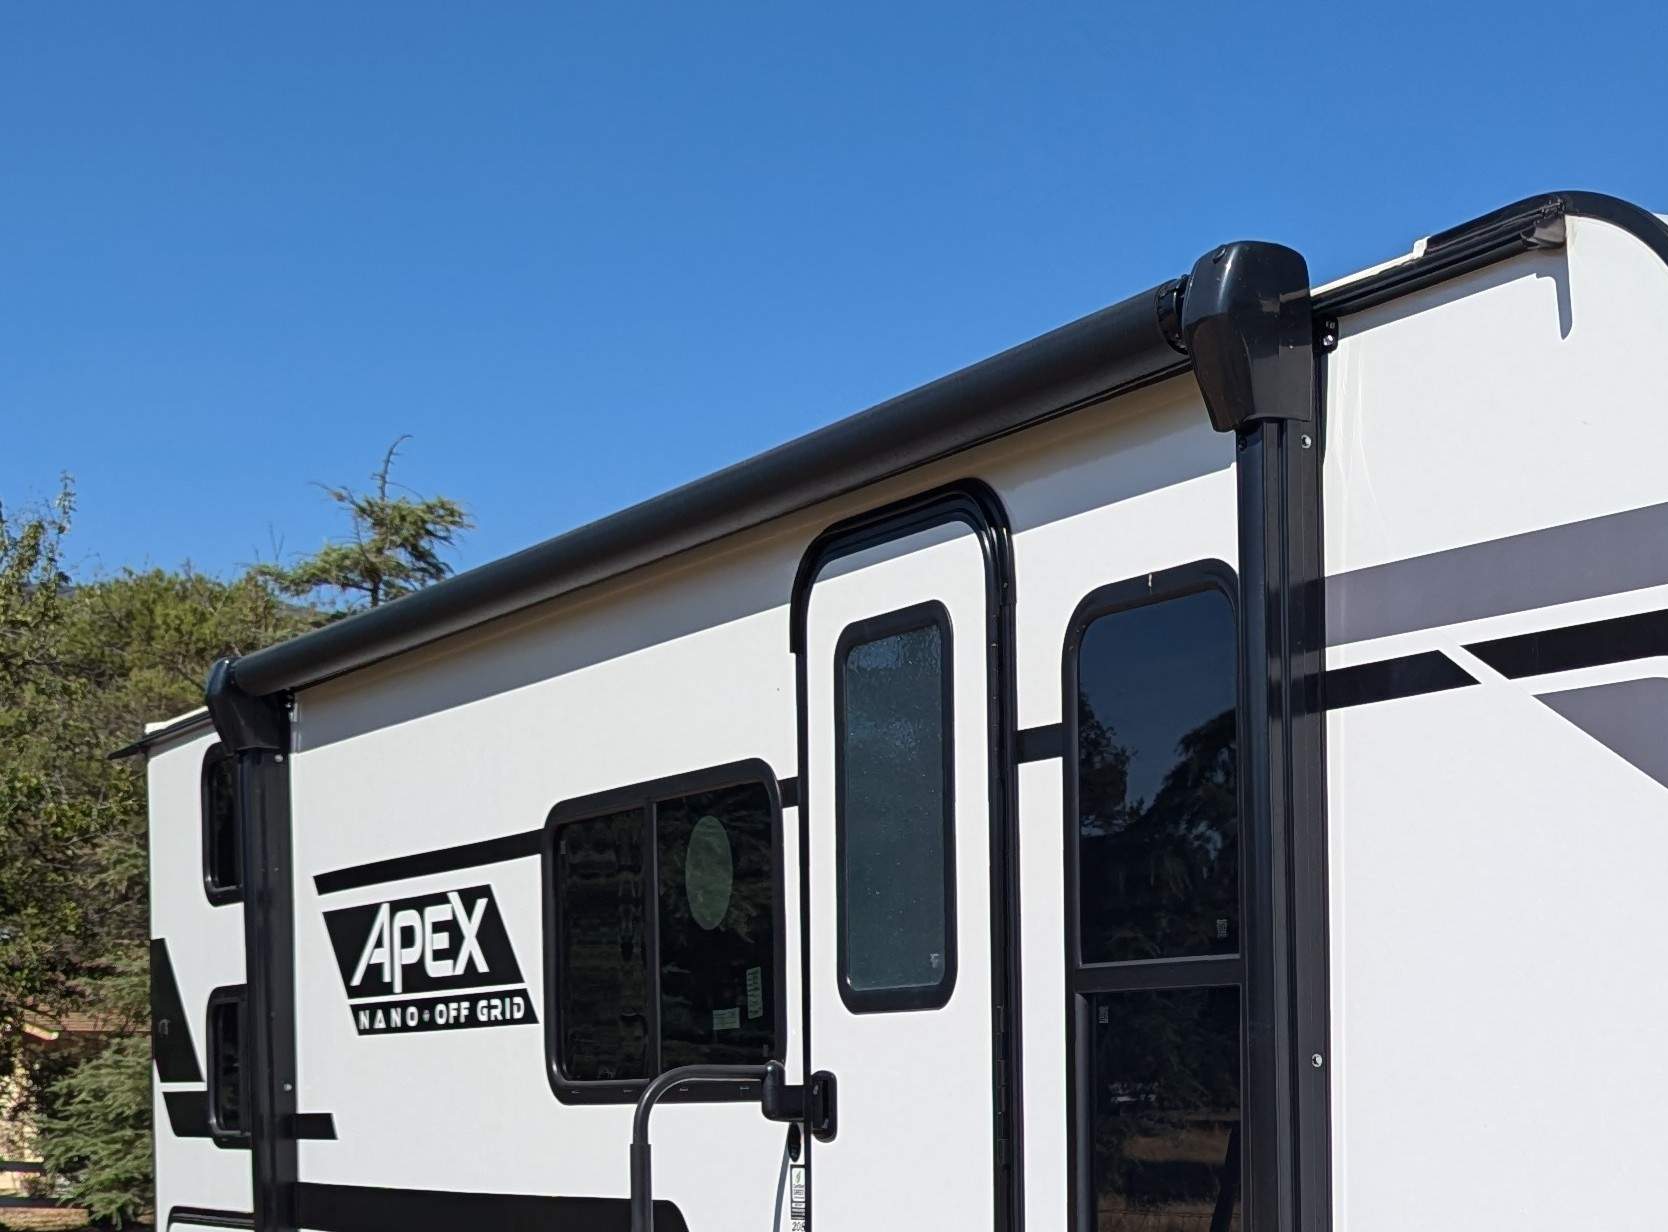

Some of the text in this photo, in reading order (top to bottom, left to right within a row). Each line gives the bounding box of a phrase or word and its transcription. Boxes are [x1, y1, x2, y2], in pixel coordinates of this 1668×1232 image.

[350, 891, 490, 993] APEX
[358, 996, 525, 1030] NANO OFF GRID
